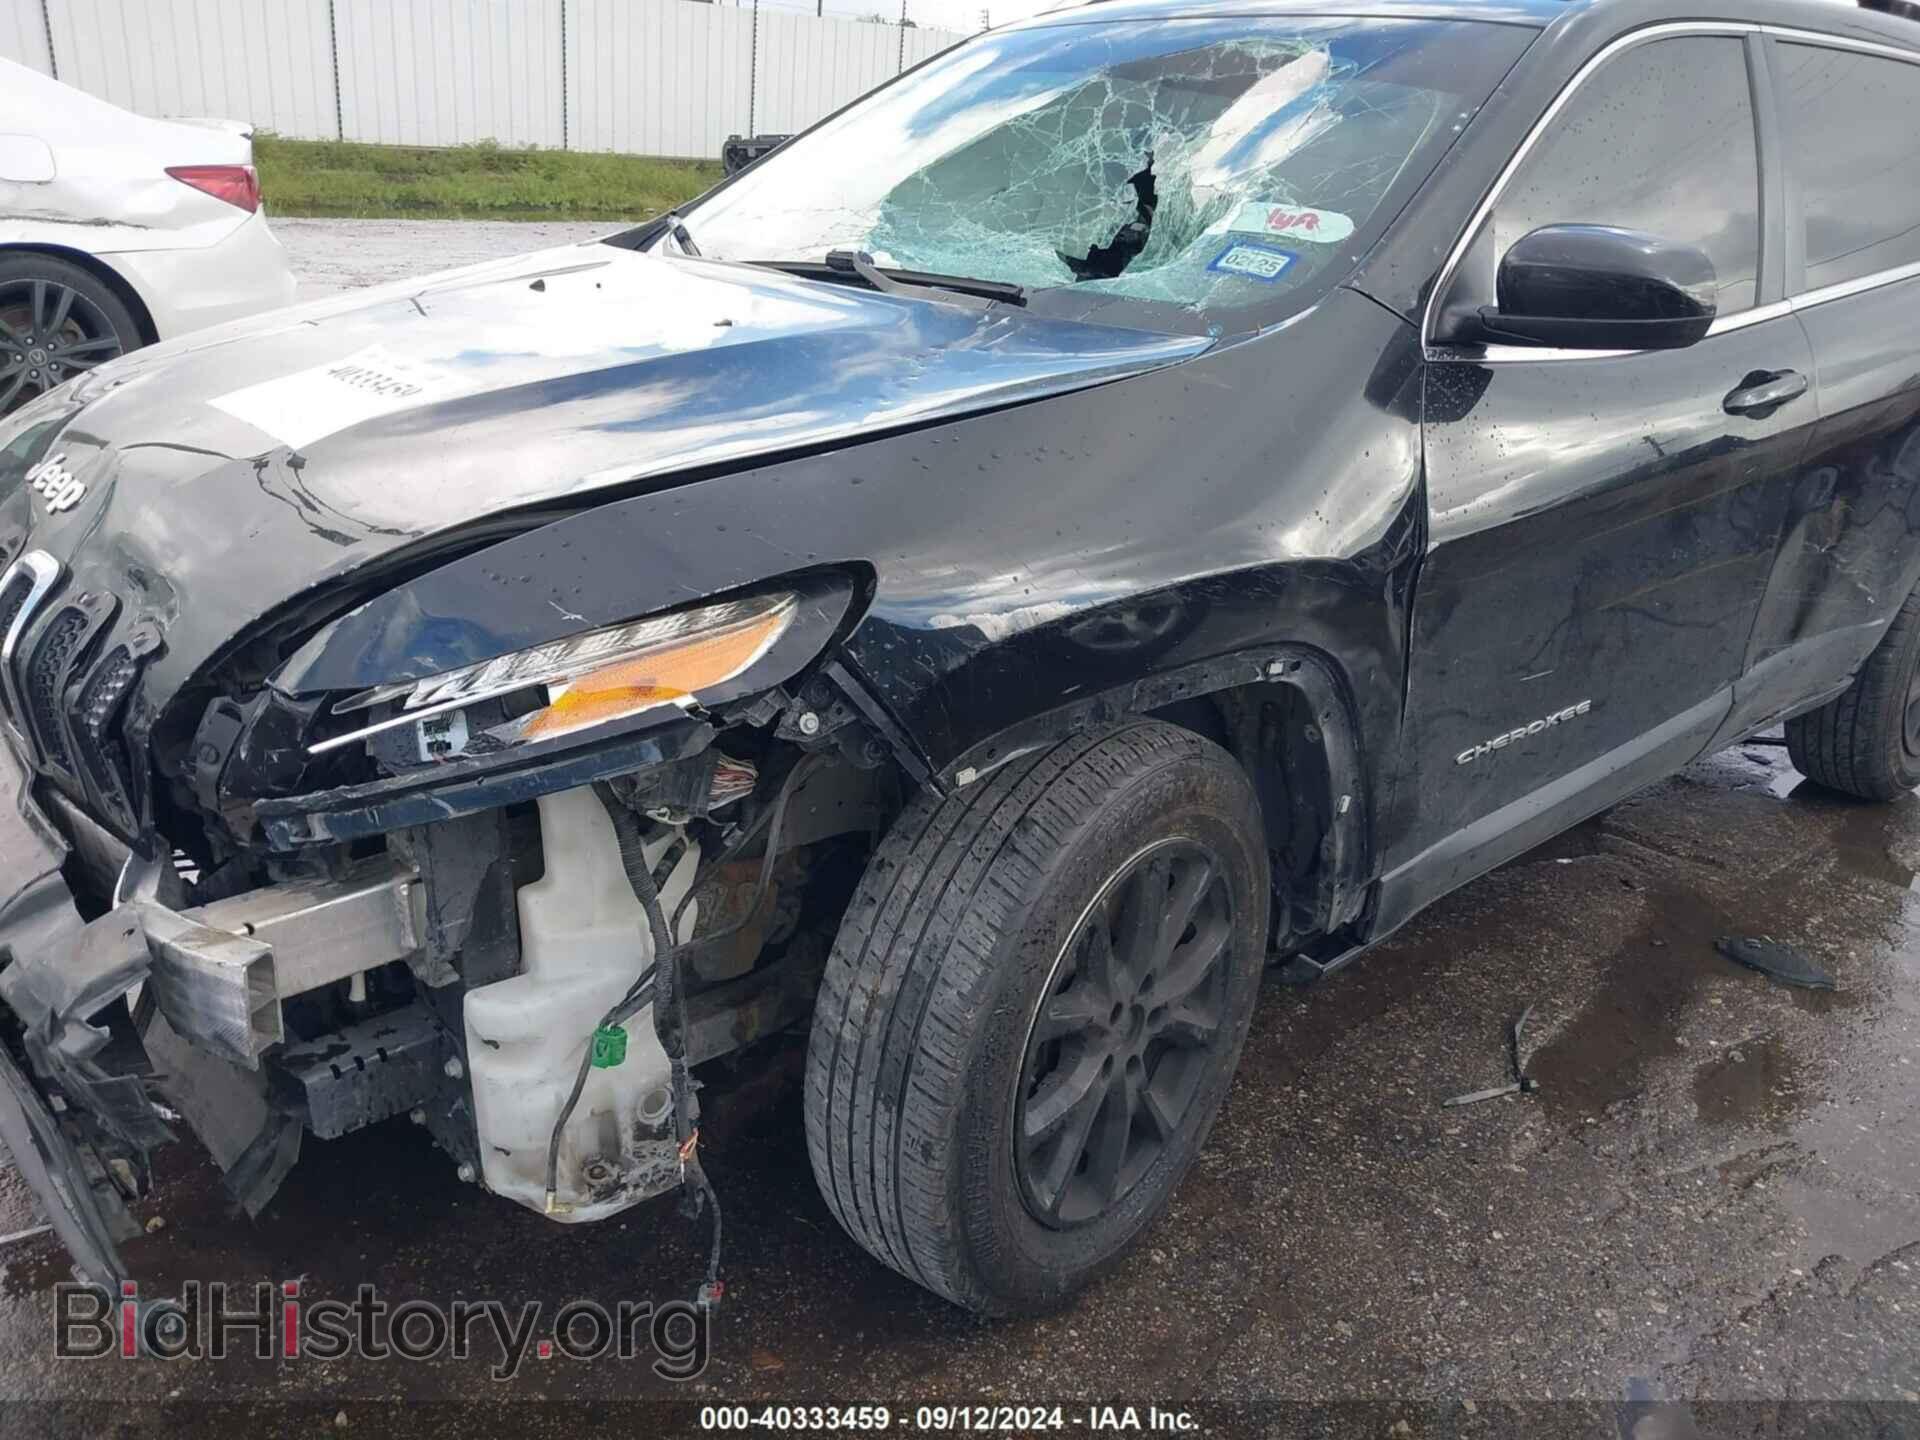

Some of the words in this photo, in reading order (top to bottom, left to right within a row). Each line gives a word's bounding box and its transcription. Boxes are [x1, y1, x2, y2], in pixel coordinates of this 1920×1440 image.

[1267, 207, 1320, 231] lyft
[1225, 253, 1248, 266] 02
[1257, 259, 1281, 273] 25
[23, 452, 86, 513] Jeep
[1456, 699, 1592, 765] CHEROKEE
